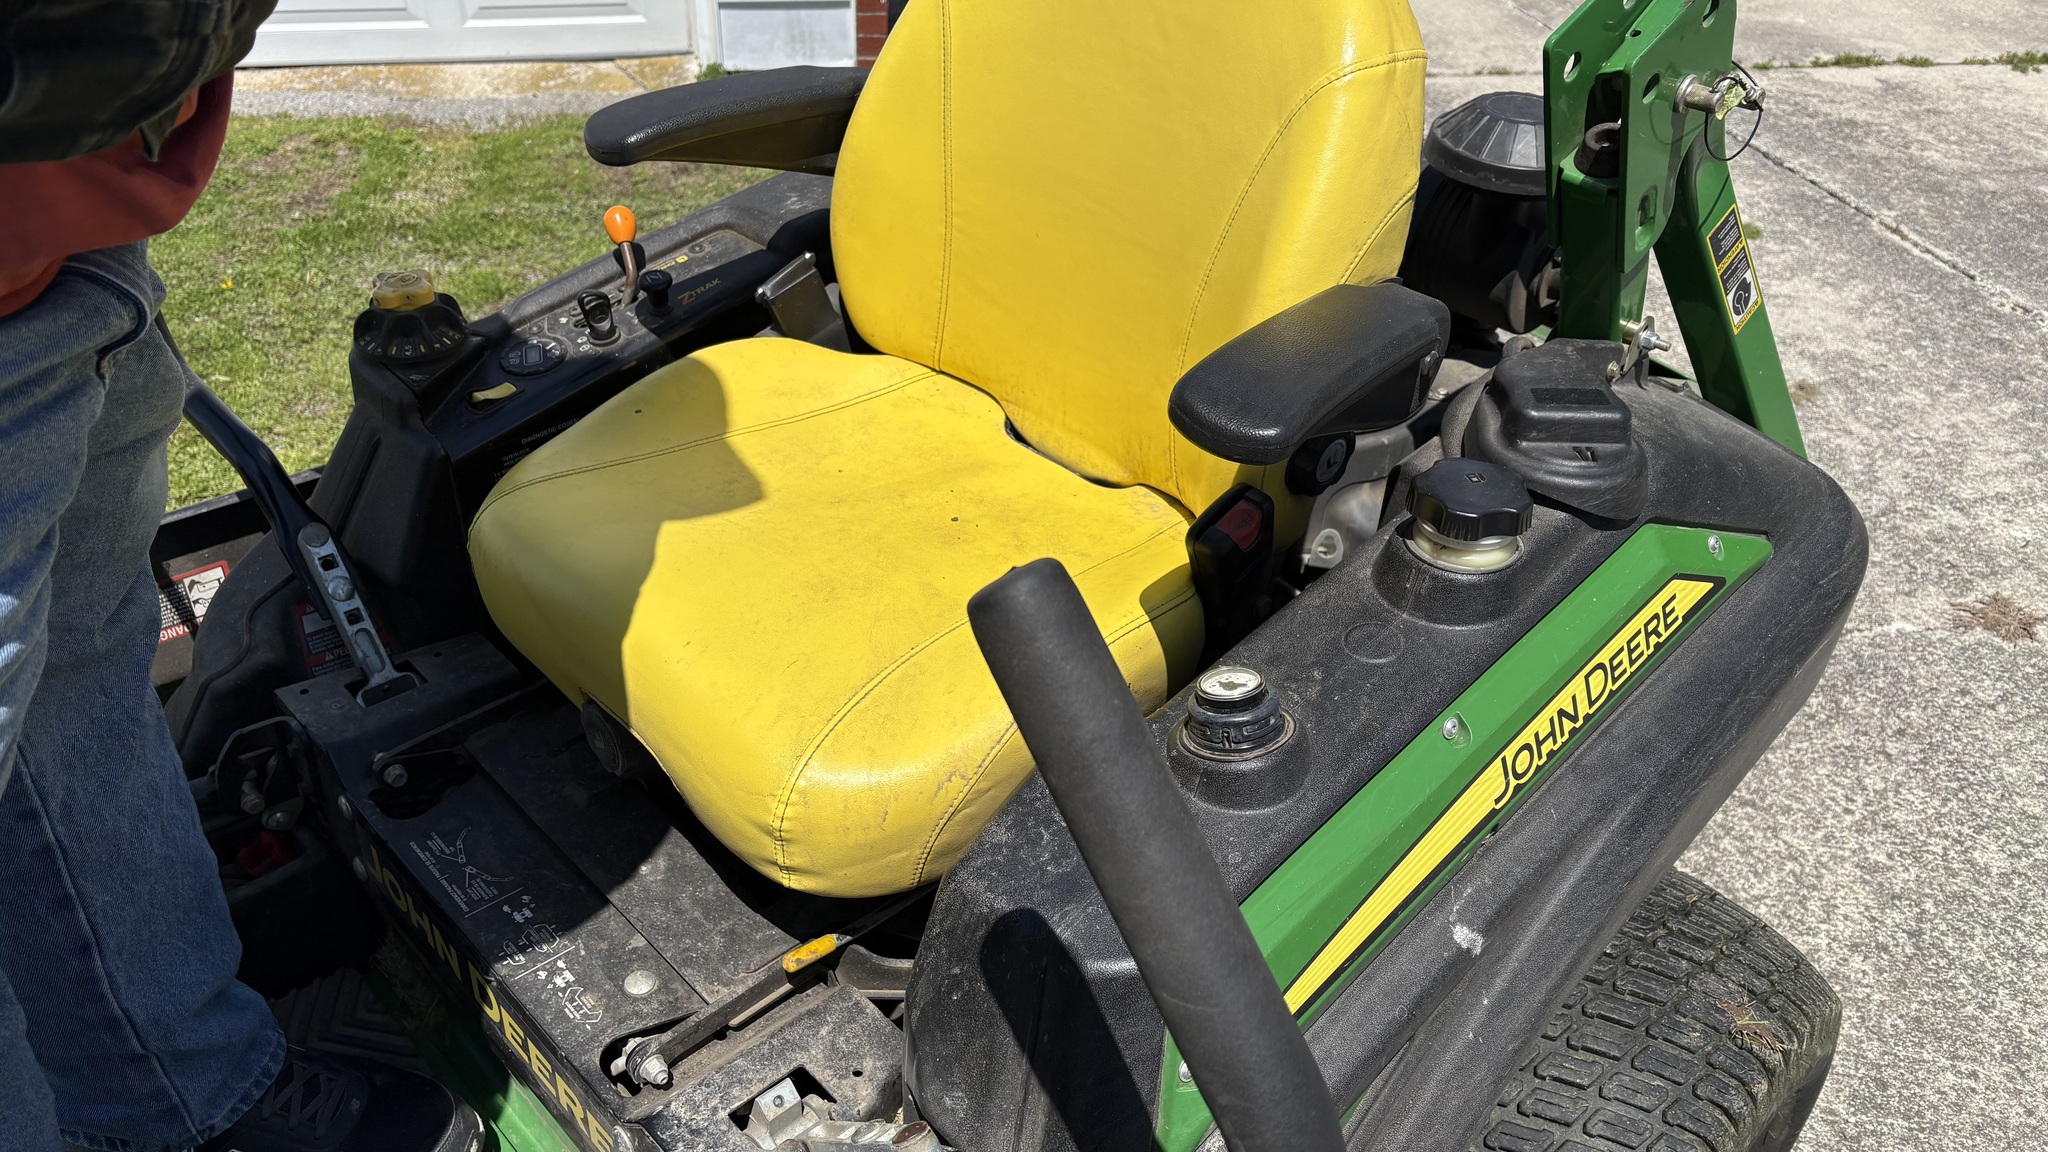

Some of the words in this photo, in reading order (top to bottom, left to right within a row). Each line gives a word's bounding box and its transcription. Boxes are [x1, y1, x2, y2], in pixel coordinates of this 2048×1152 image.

[1736, 304, 1757, 331] CAUTION
[521, 426, 557, 445] DIAGNOSTIC
[159, 622, 193, 641] DANG
[1493, 693, 1580, 807] JOHN
[1585, 593, 1681, 711] DEERE
[367, 846, 463, 982] JOHN
[468, 961, 615, 1152] DEERE
